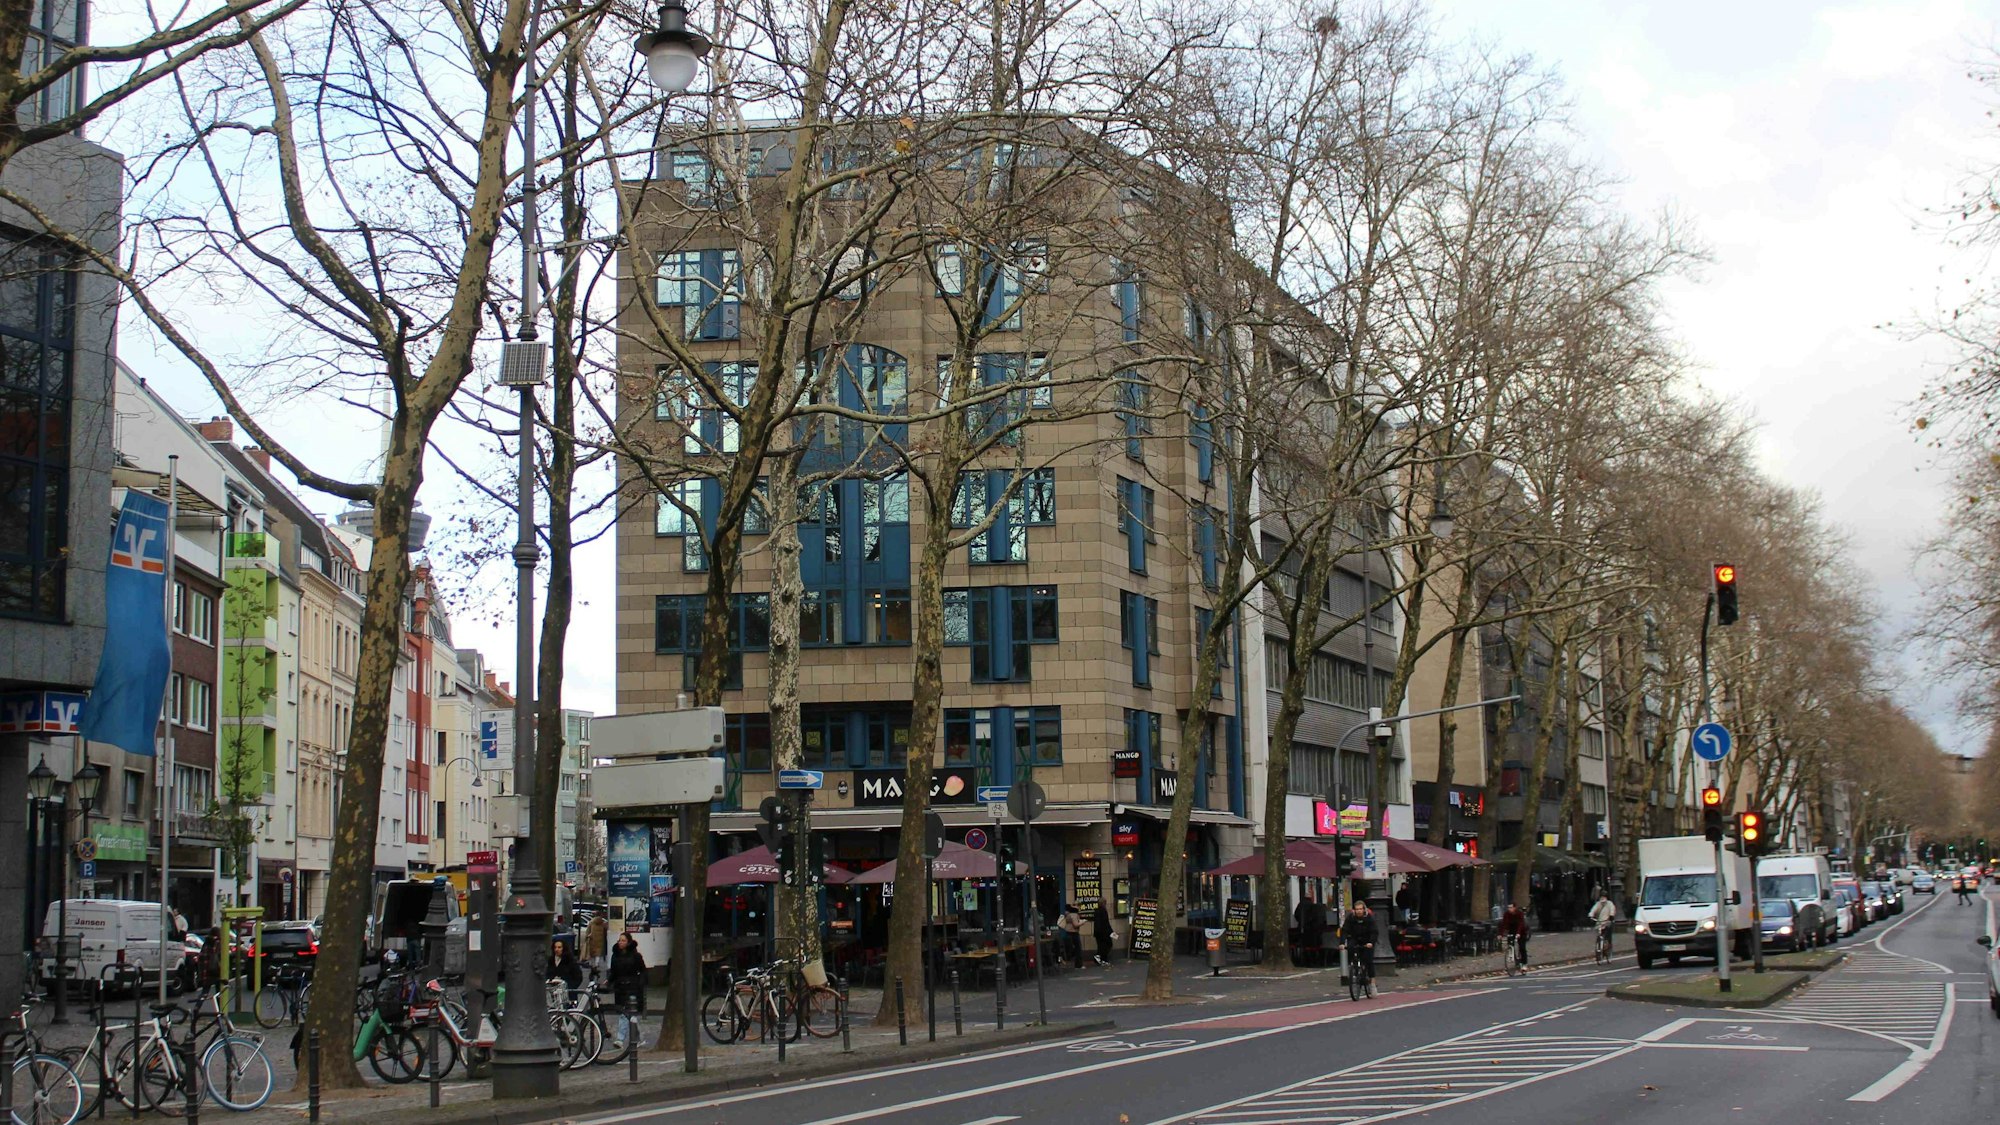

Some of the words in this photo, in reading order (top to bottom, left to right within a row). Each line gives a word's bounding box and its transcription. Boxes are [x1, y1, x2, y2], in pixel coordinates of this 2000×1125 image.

[1119, 825, 1132, 833] sky
[84, 864, 92, 876] P
[566, 862, 574, 872] P
[75, 918, 105, 926] Jansen
